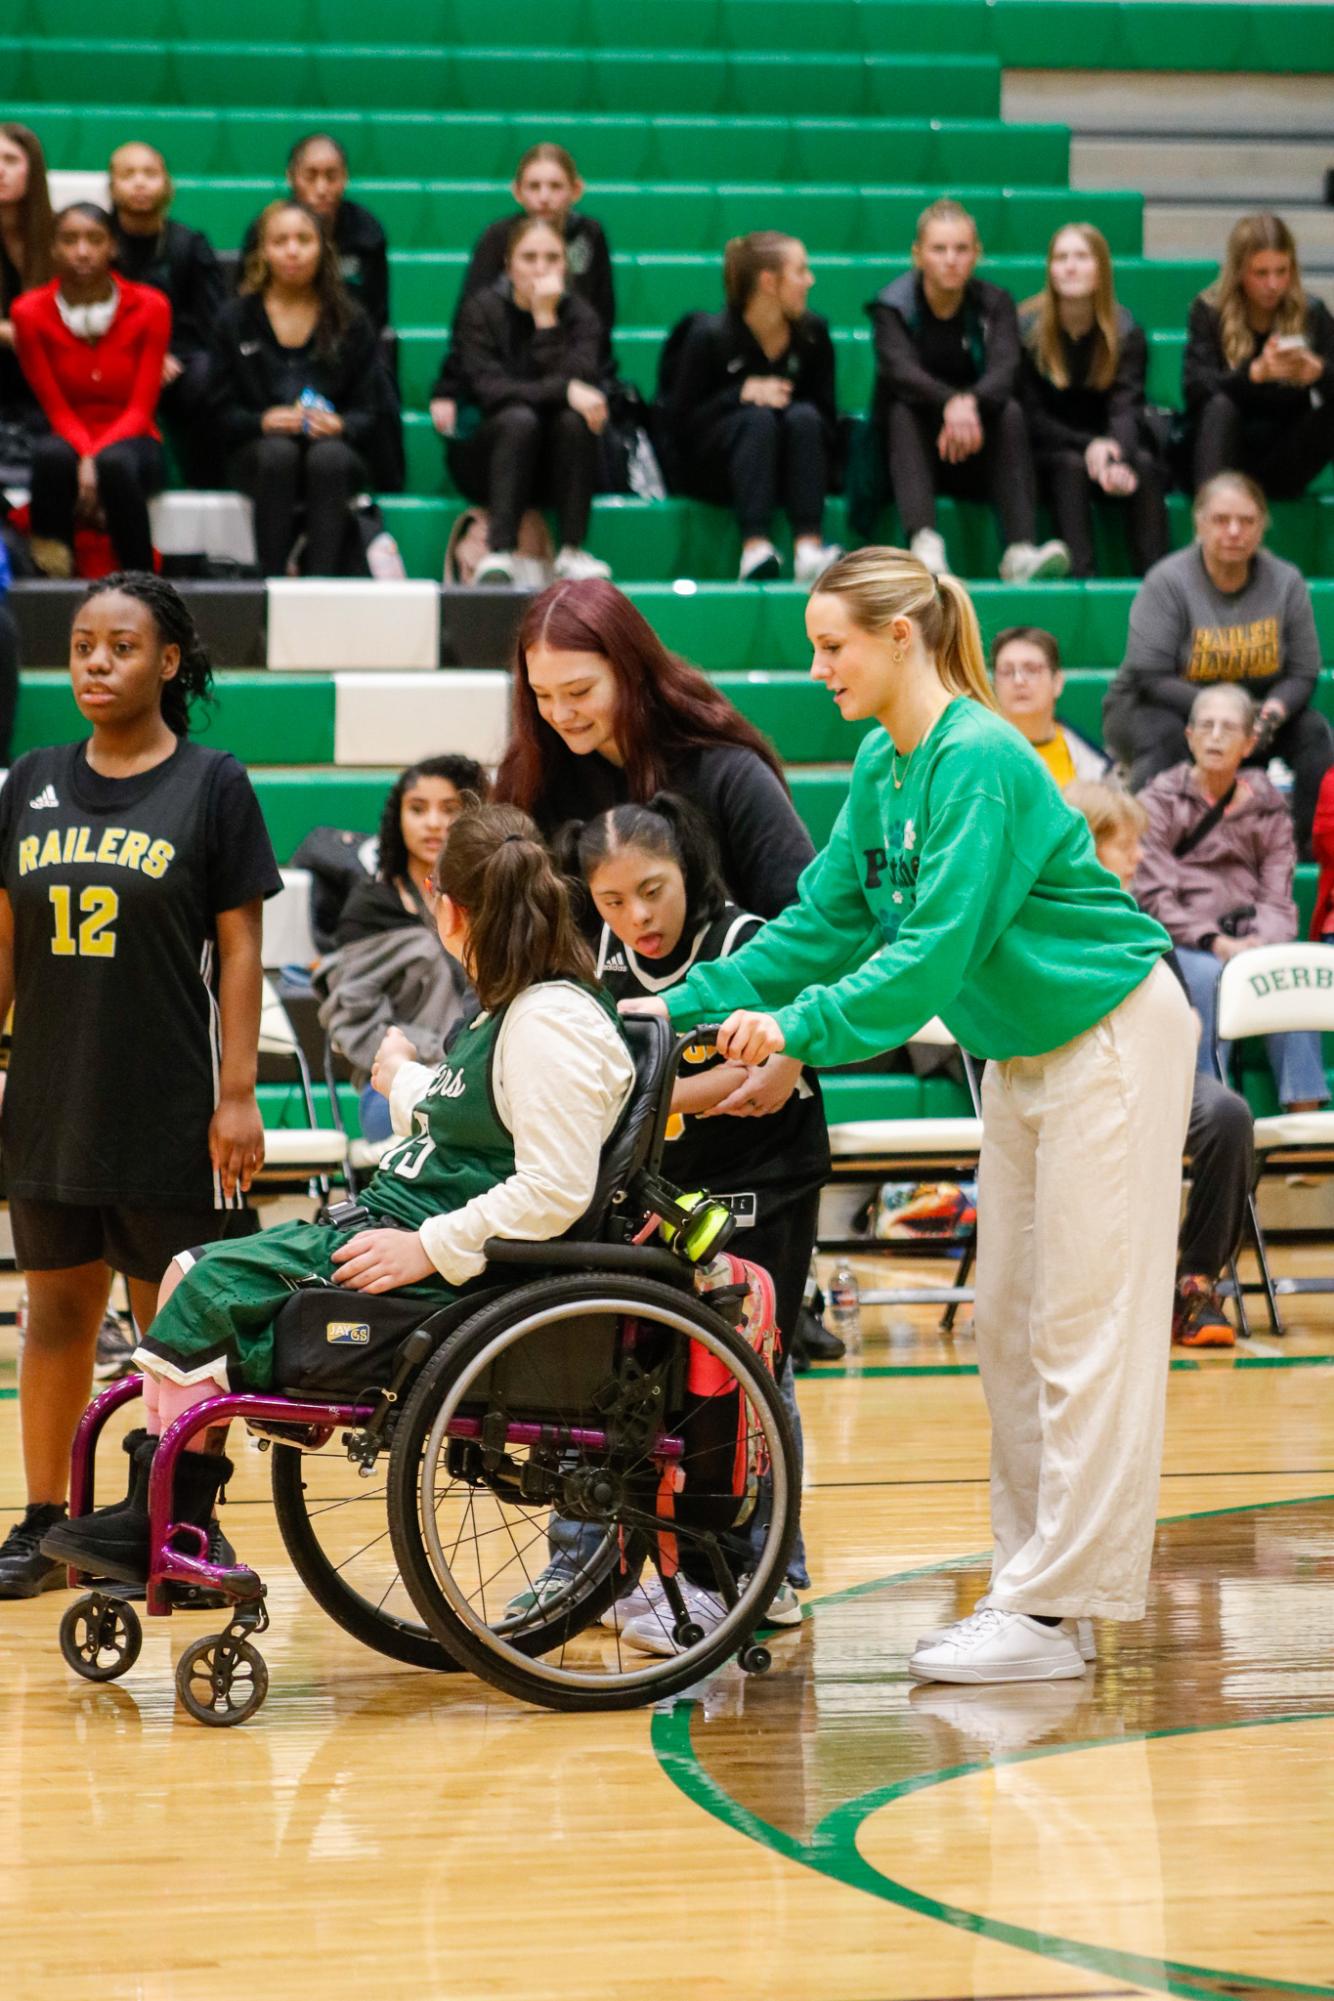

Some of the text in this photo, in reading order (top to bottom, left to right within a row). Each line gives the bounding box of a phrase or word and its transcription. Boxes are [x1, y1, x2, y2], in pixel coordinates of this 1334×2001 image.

[19, 826, 176, 879] RAILERS
[48, 884, 119, 958] 12
[1248, 966, 1334, 998] DERB
